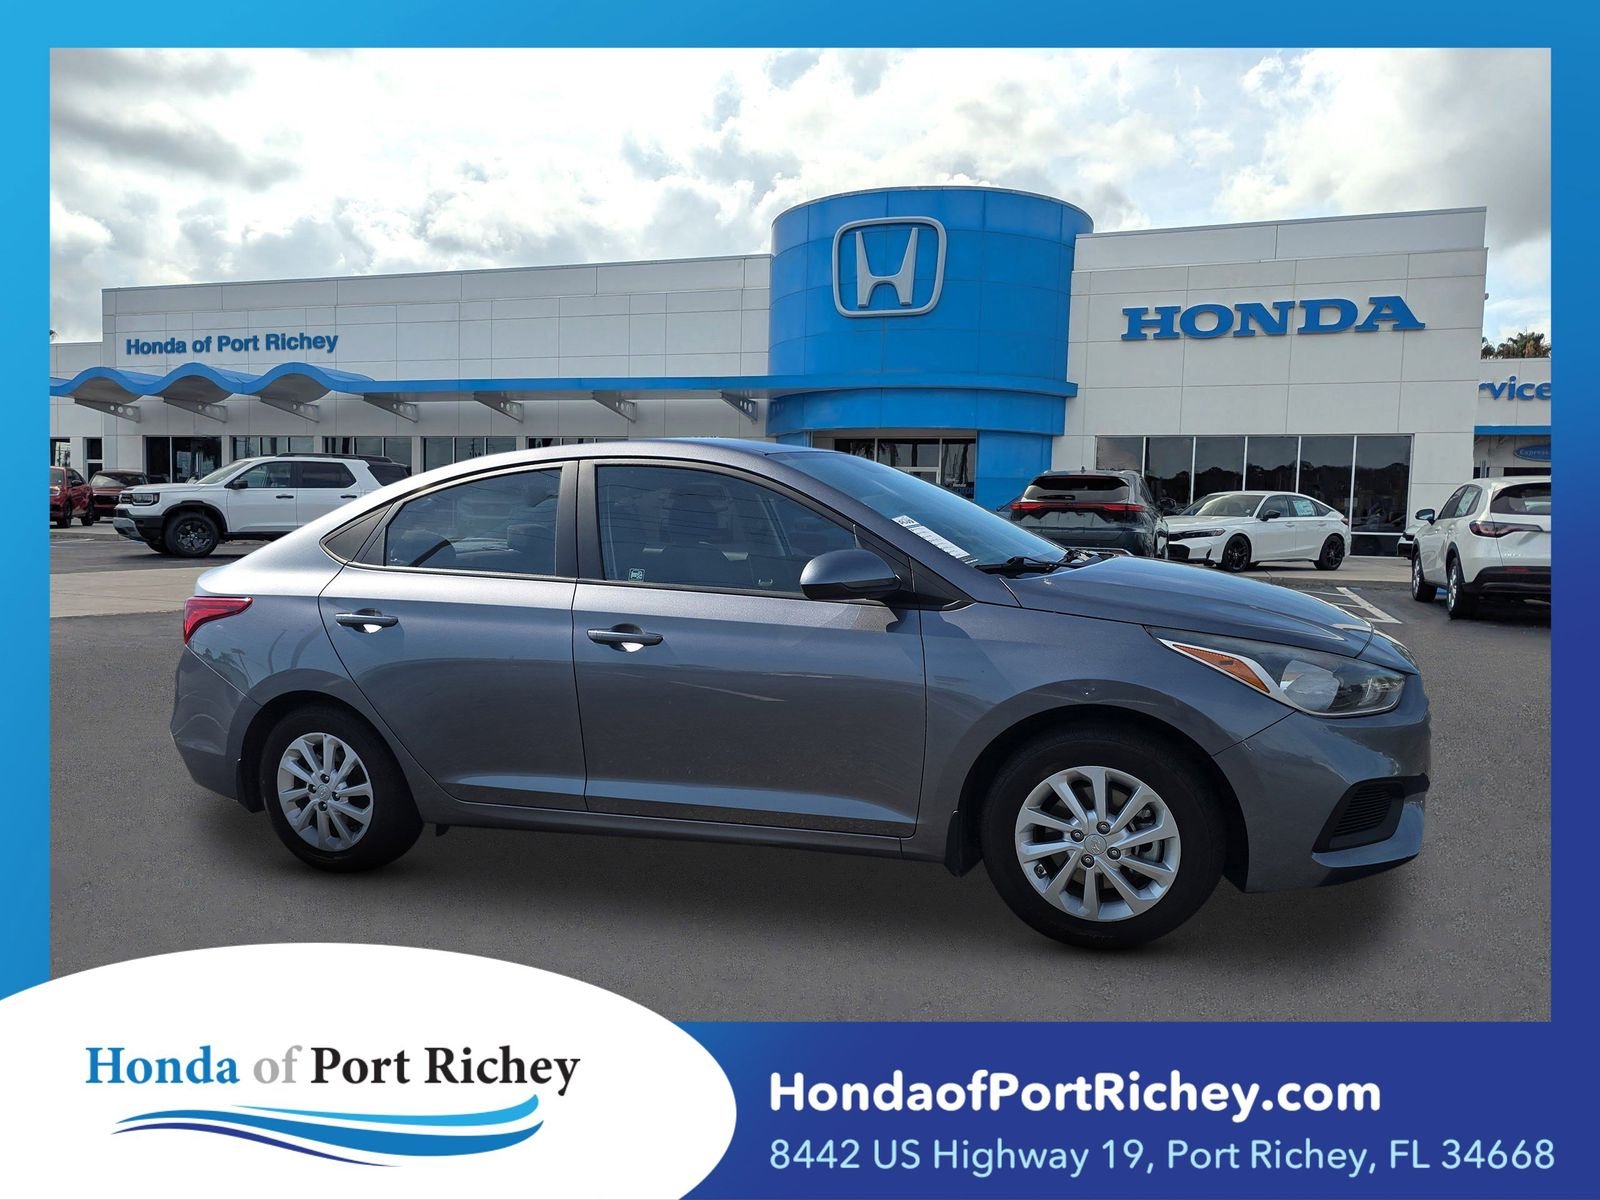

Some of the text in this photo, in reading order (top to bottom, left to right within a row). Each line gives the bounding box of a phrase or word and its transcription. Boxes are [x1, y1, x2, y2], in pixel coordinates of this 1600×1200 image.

[1121, 295, 1425, 341] HONDA
[125, 332, 339, 355] Honda of Port Richey
